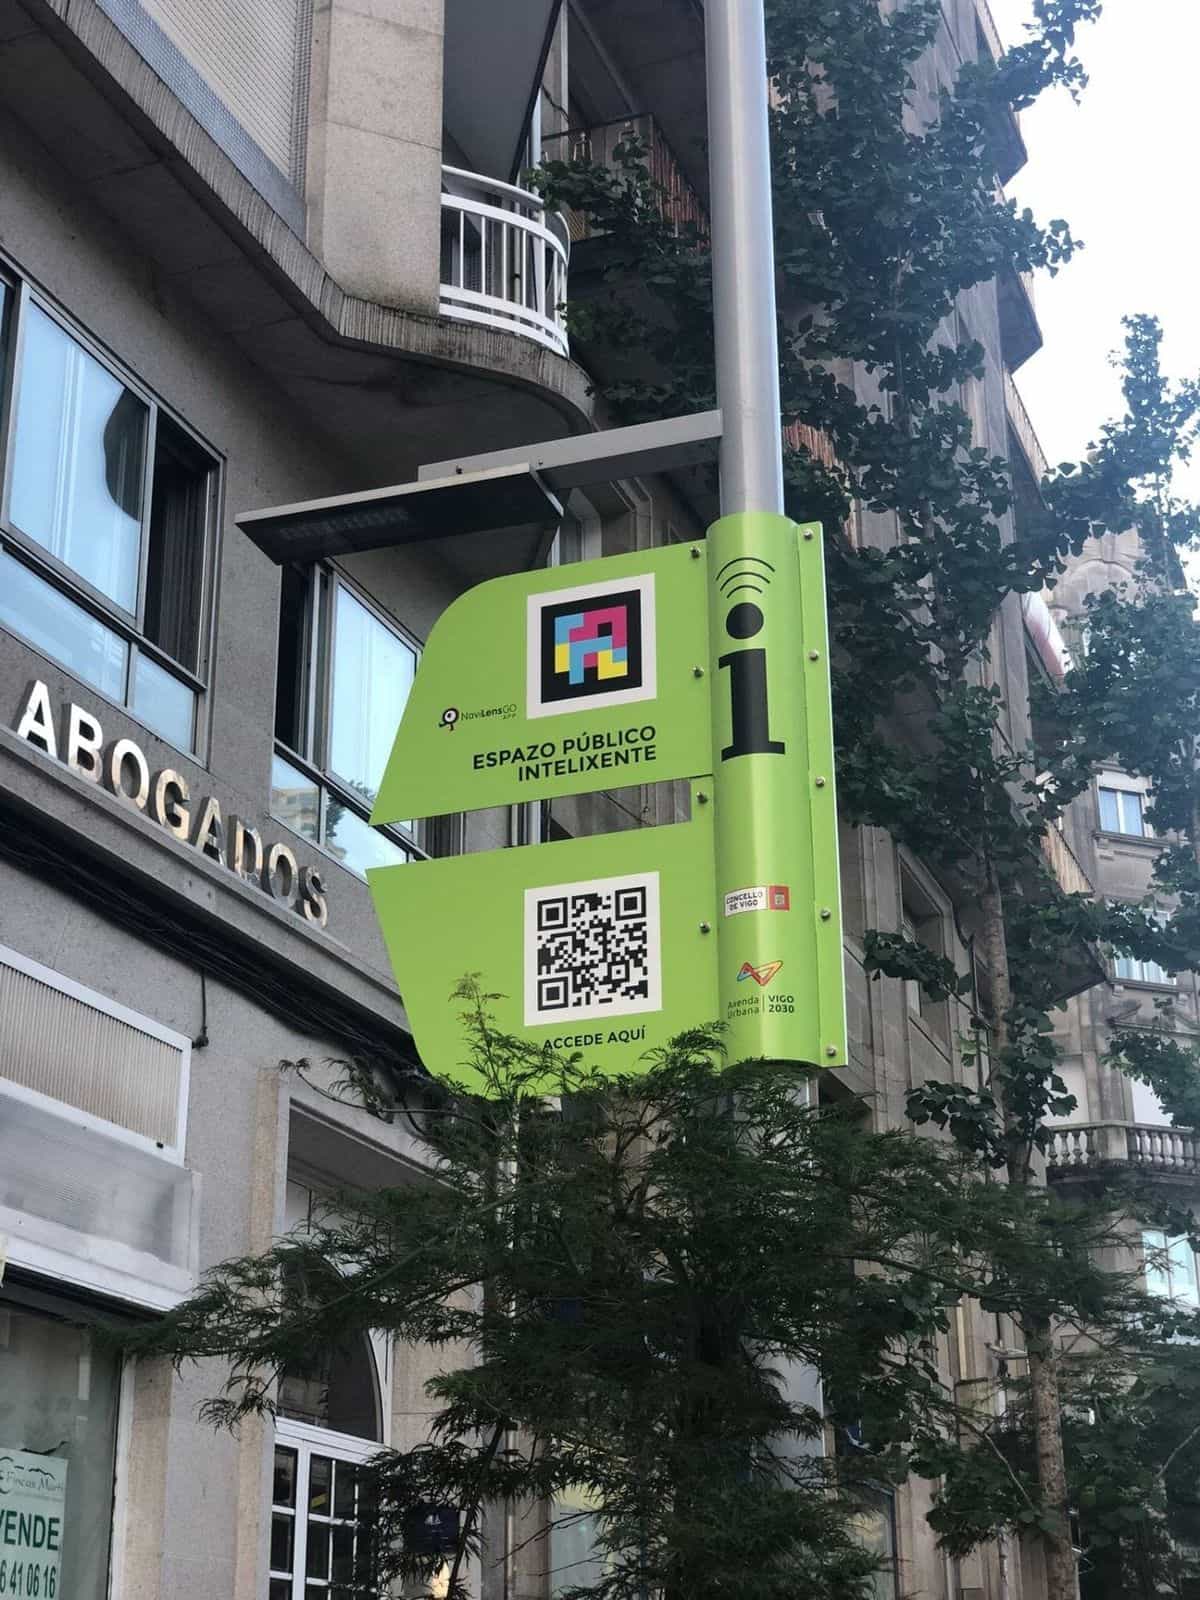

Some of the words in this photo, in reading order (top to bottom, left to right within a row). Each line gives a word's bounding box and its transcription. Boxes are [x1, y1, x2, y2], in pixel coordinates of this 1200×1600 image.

[473, 742, 555, 770] ESPAZO
[563, 725, 656, 754] PÚBLICO
[518, 745, 656, 782] INTELIXENTE
[16, 679, 328, 926] ABOGADOS
[726, 891, 763, 905] CONCELLO
[740, 899, 758, 908] VIGO
[768, 995, 794, 1003] VIGO
[768, 1004, 795, 1013] 2030
[543, 1033, 603, 1051] ACCEDE
[607, 1025, 646, 1043] AQUÍ
[10, 1561, 23, 1596] 41
[26, 1563, 40, 1597] 06
[43, 1564, 56, 1599] 16
